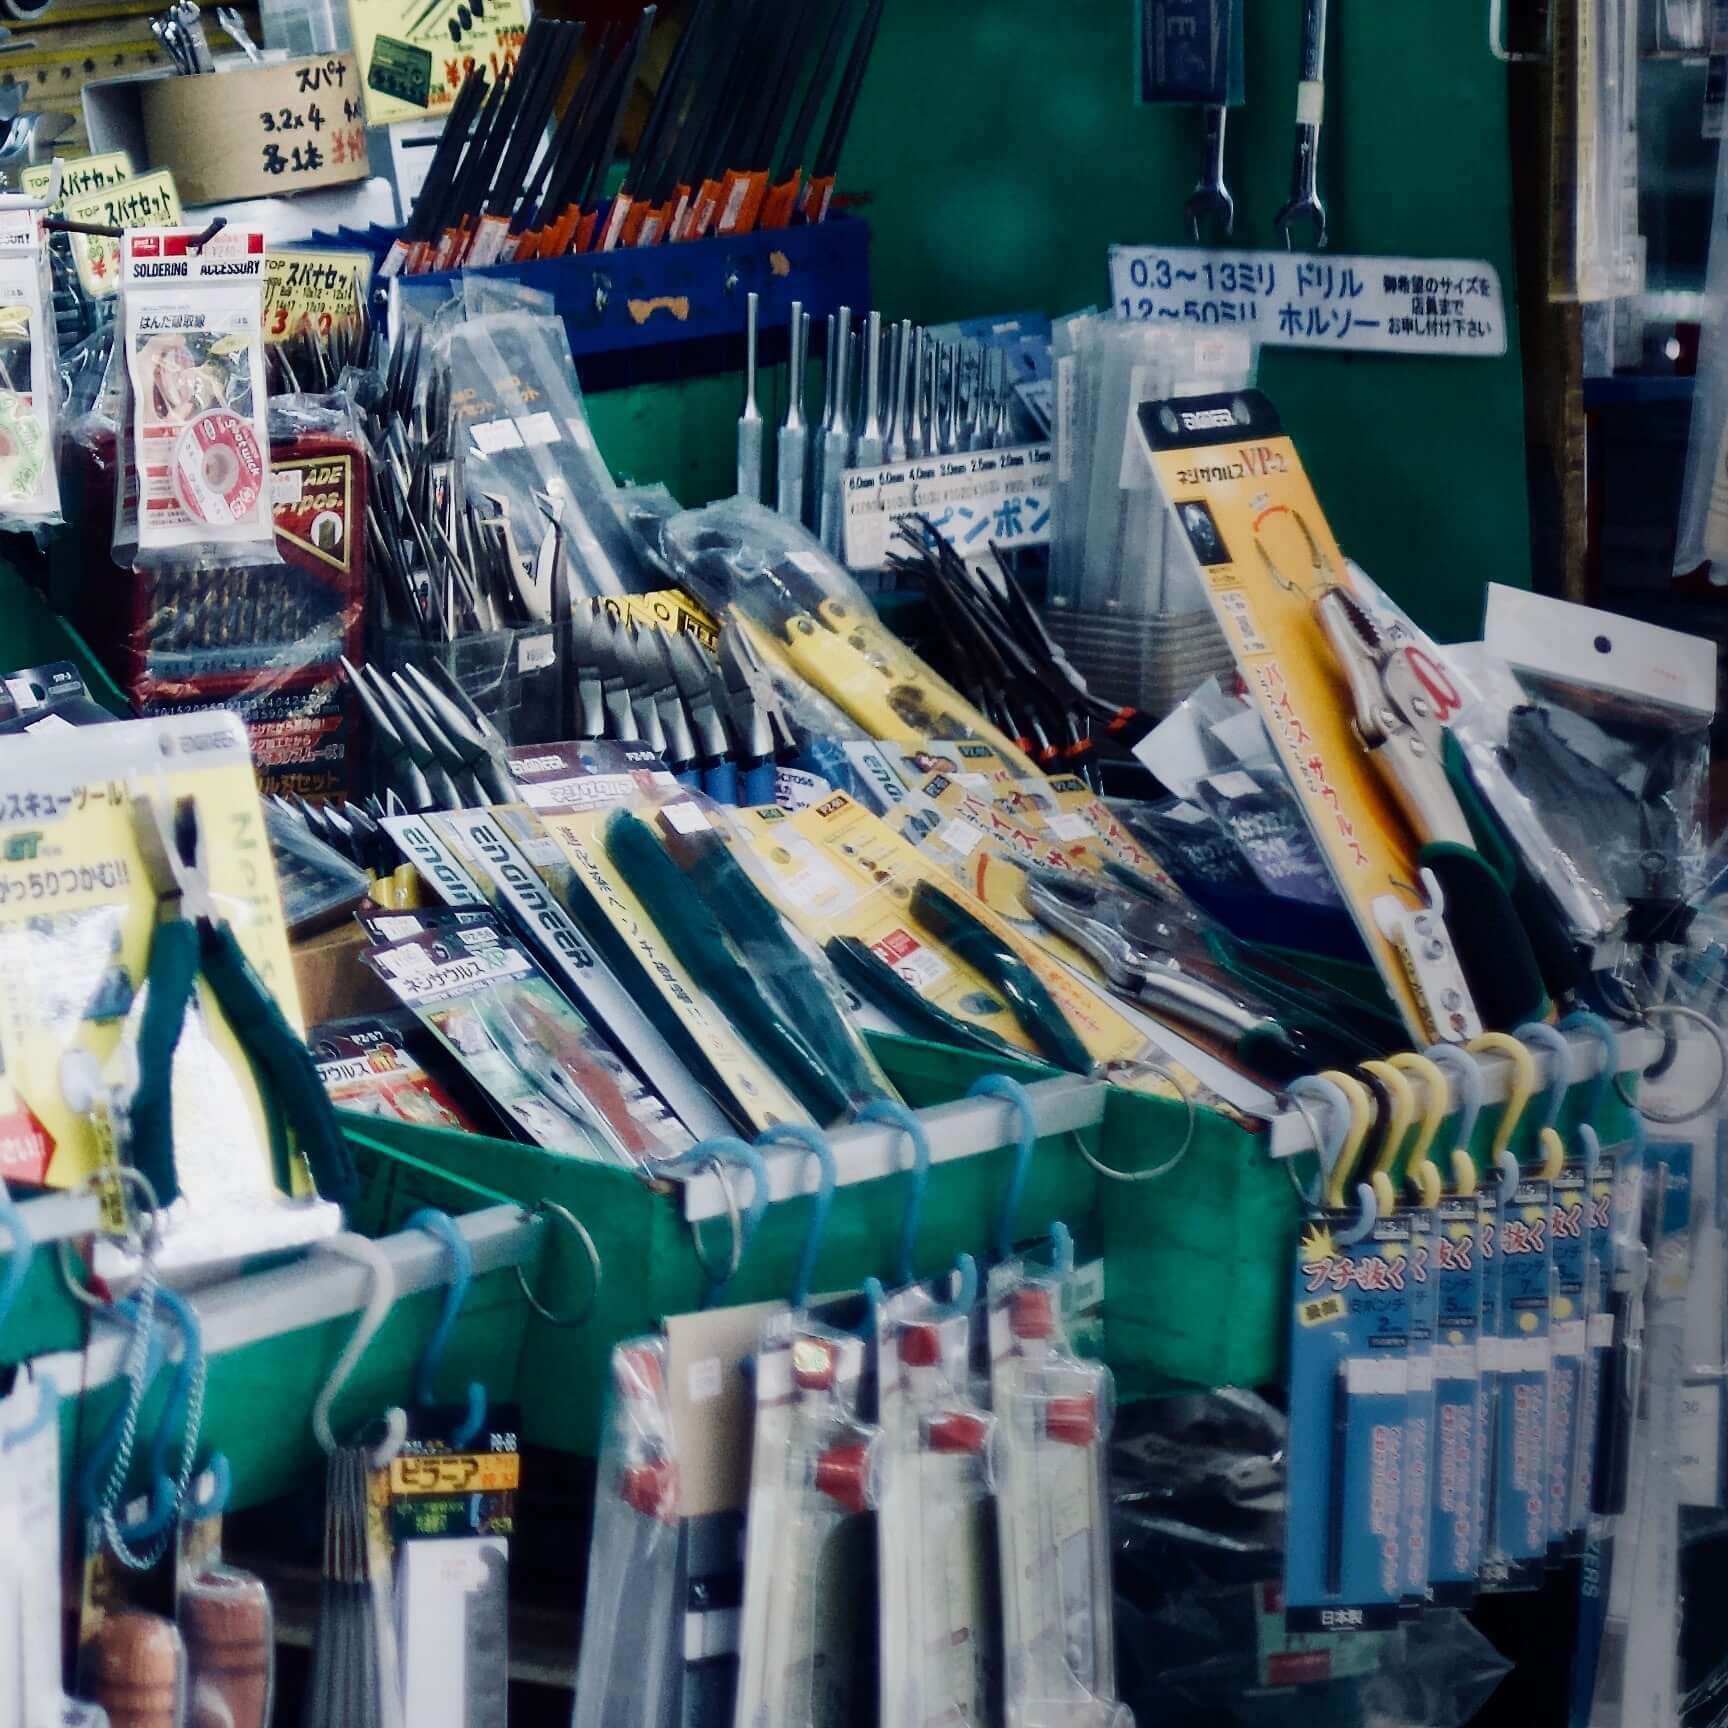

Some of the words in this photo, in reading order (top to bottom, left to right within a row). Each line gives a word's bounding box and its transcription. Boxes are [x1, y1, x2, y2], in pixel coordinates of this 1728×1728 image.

[296, 61, 346, 93] スパナ
[28, 176, 50, 188] TOP
[77, 206, 101, 218] TOP
[104, 185, 172, 227] スパナセット
[132, 261, 188, 278] SOLDERING
[1296, 263, 1364, 299] ドリル
[1383, 275, 1491, 297] 御希望のサイズを
[1278, 302, 1380, 339] ホルソー
[1410, 296, 1465, 316] 店員まで
[1387, 318, 1493, 338] お申し付け下さい
[403, 826, 488, 904] ENGIN
[469, 823, 595, 970] ENGINEER
[1302, 1257, 1405, 1292] プチ抜く
[1320, 1609, 1364, 1626] 日本製
